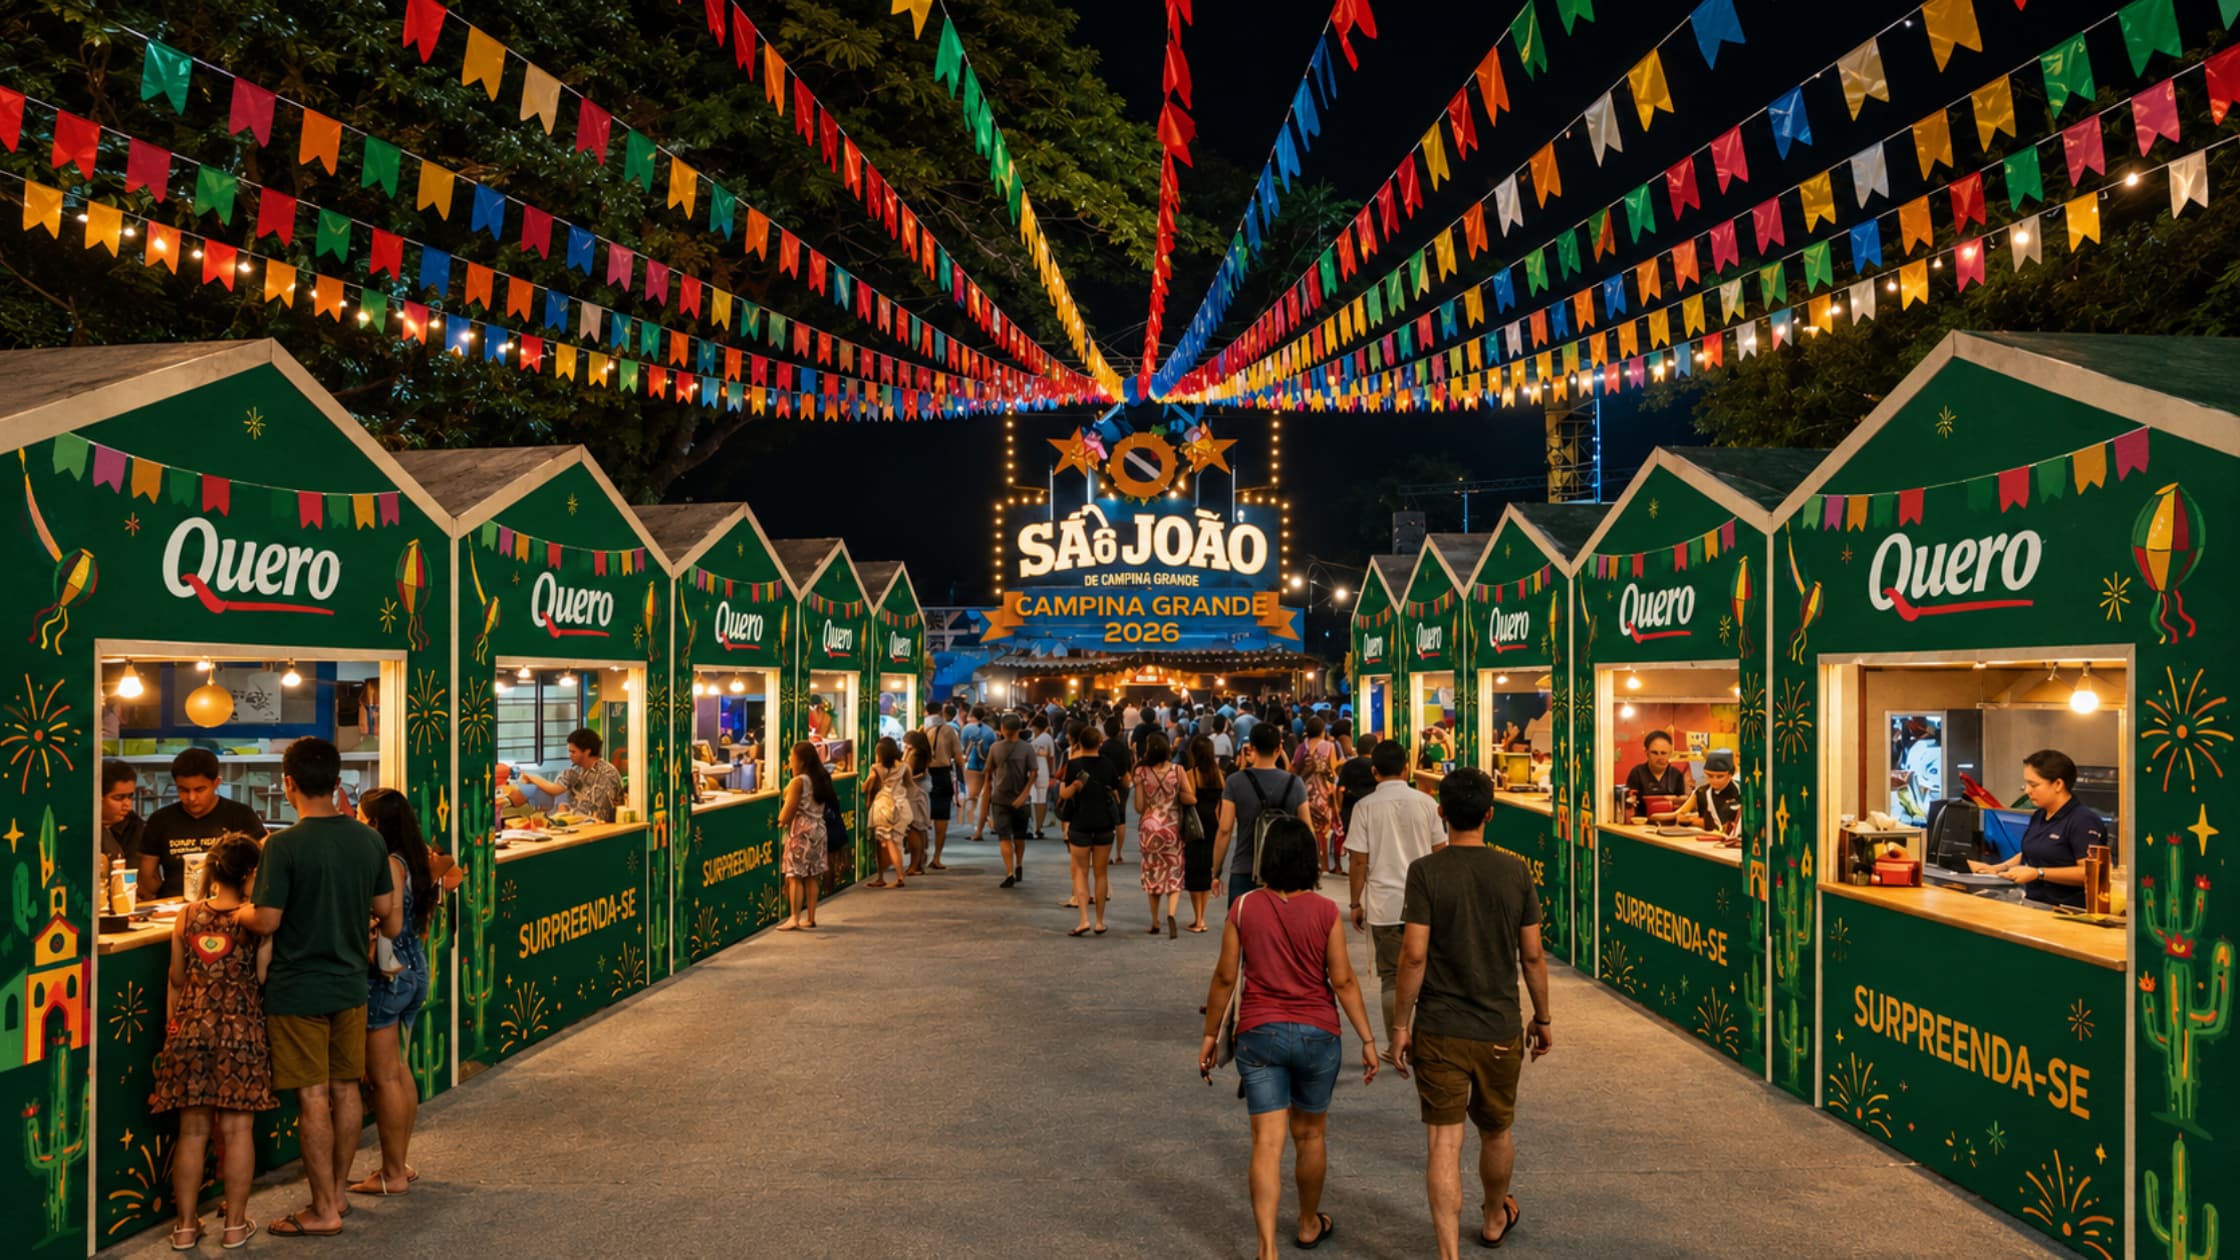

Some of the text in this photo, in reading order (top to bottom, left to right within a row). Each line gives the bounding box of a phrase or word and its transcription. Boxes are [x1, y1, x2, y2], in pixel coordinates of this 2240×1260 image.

[163, 517, 341, 614] Quero
[1121, 508, 1268, 576] JOÃO
[532, 572, 614, 637] Quero
[1084, 572, 1200, 587] DE CAMPINA GRANDE
[1869, 530, 2042, 621] Quero
[715, 601, 764, 650] Quero
[1016, 596, 1270, 617] CAMPINA GRANDE
[1104, 622, 1181, 643] 2026
[1489, 607, 1530, 653] Quero
[1619, 583, 1695, 643] Quero
[823, 619, 853, 658] Quero
[703, 839, 773, 888] SURPREENDA-SE
[519, 887, 637, 960] SURPREENDA-SE
[1615, 892, 1729, 967] SURPREENDA-SE
[1853, 985, 2091, 1120] SURPREENDA-SE
